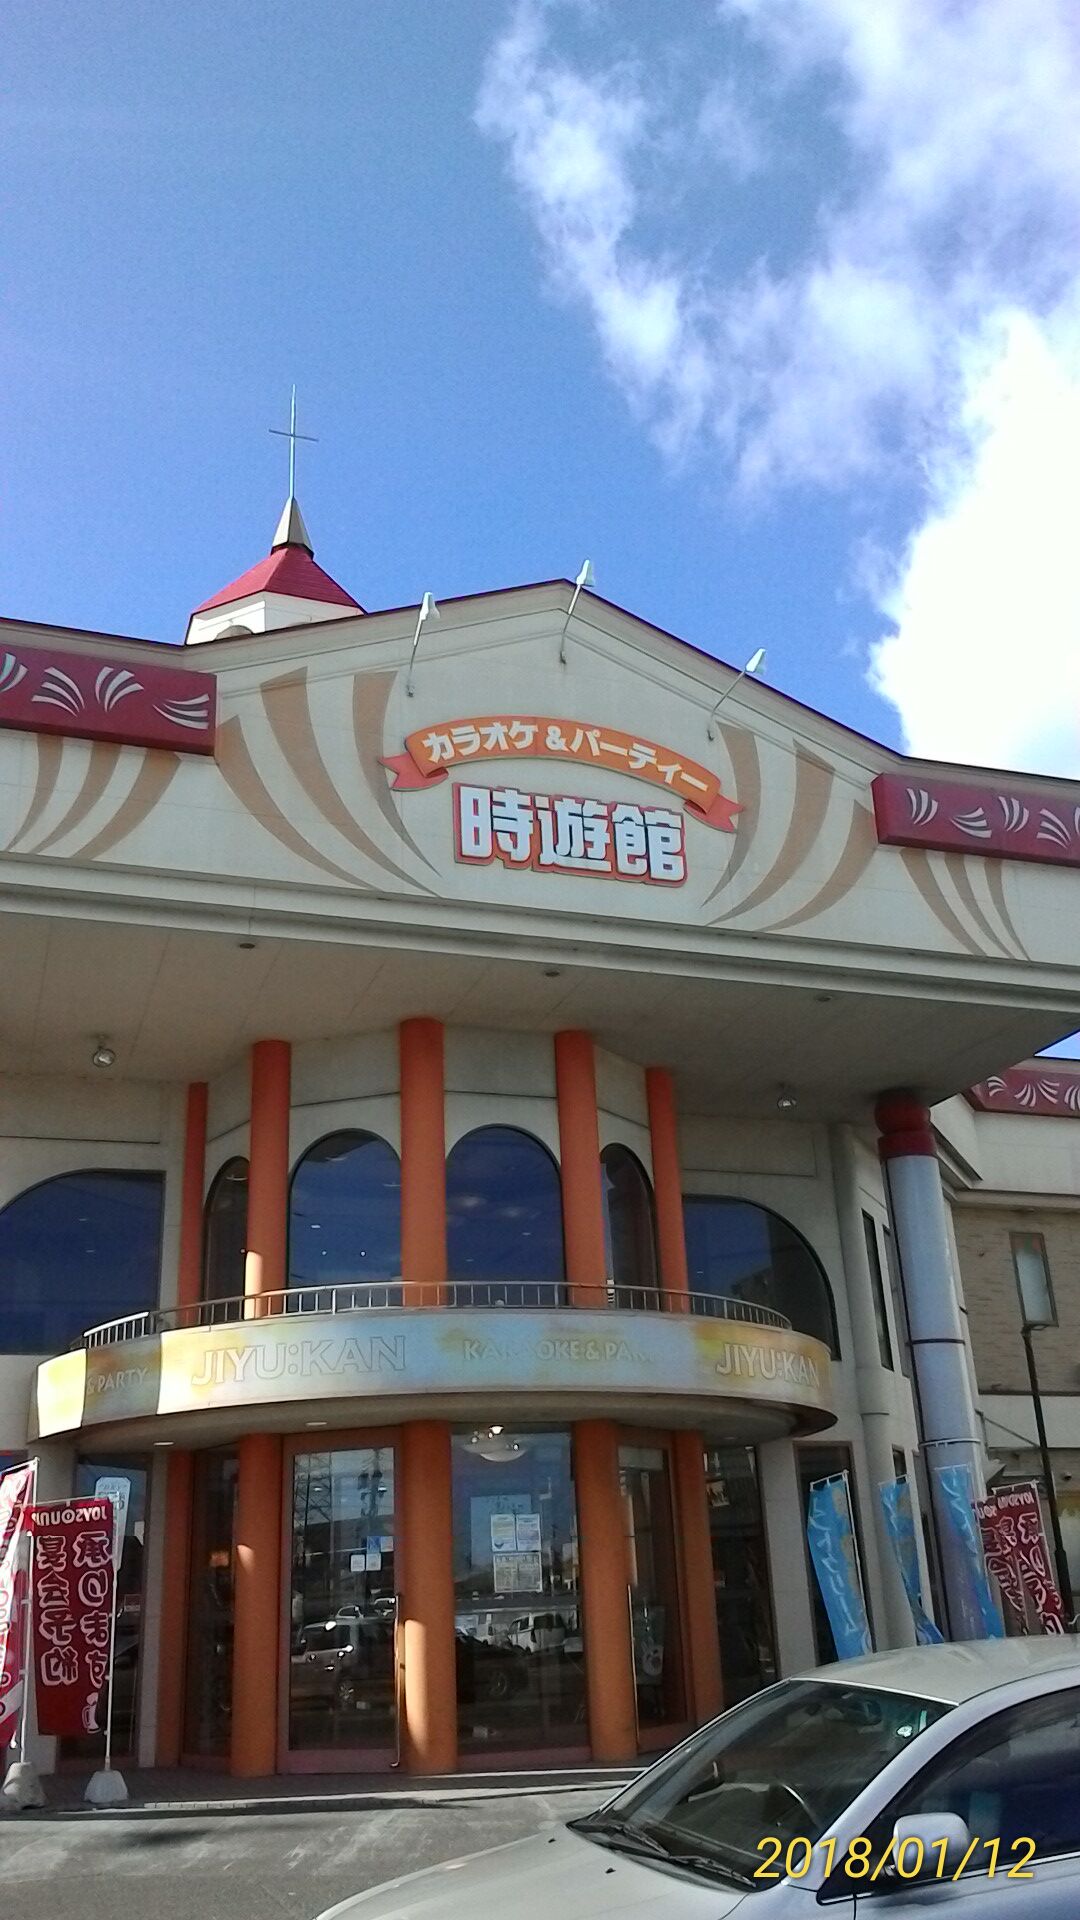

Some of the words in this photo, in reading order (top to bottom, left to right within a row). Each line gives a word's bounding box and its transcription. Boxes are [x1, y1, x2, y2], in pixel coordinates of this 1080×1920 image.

[458, 786, 686, 882] 時遊館
[191, 1335, 406, 1386] JIYU:KAN
